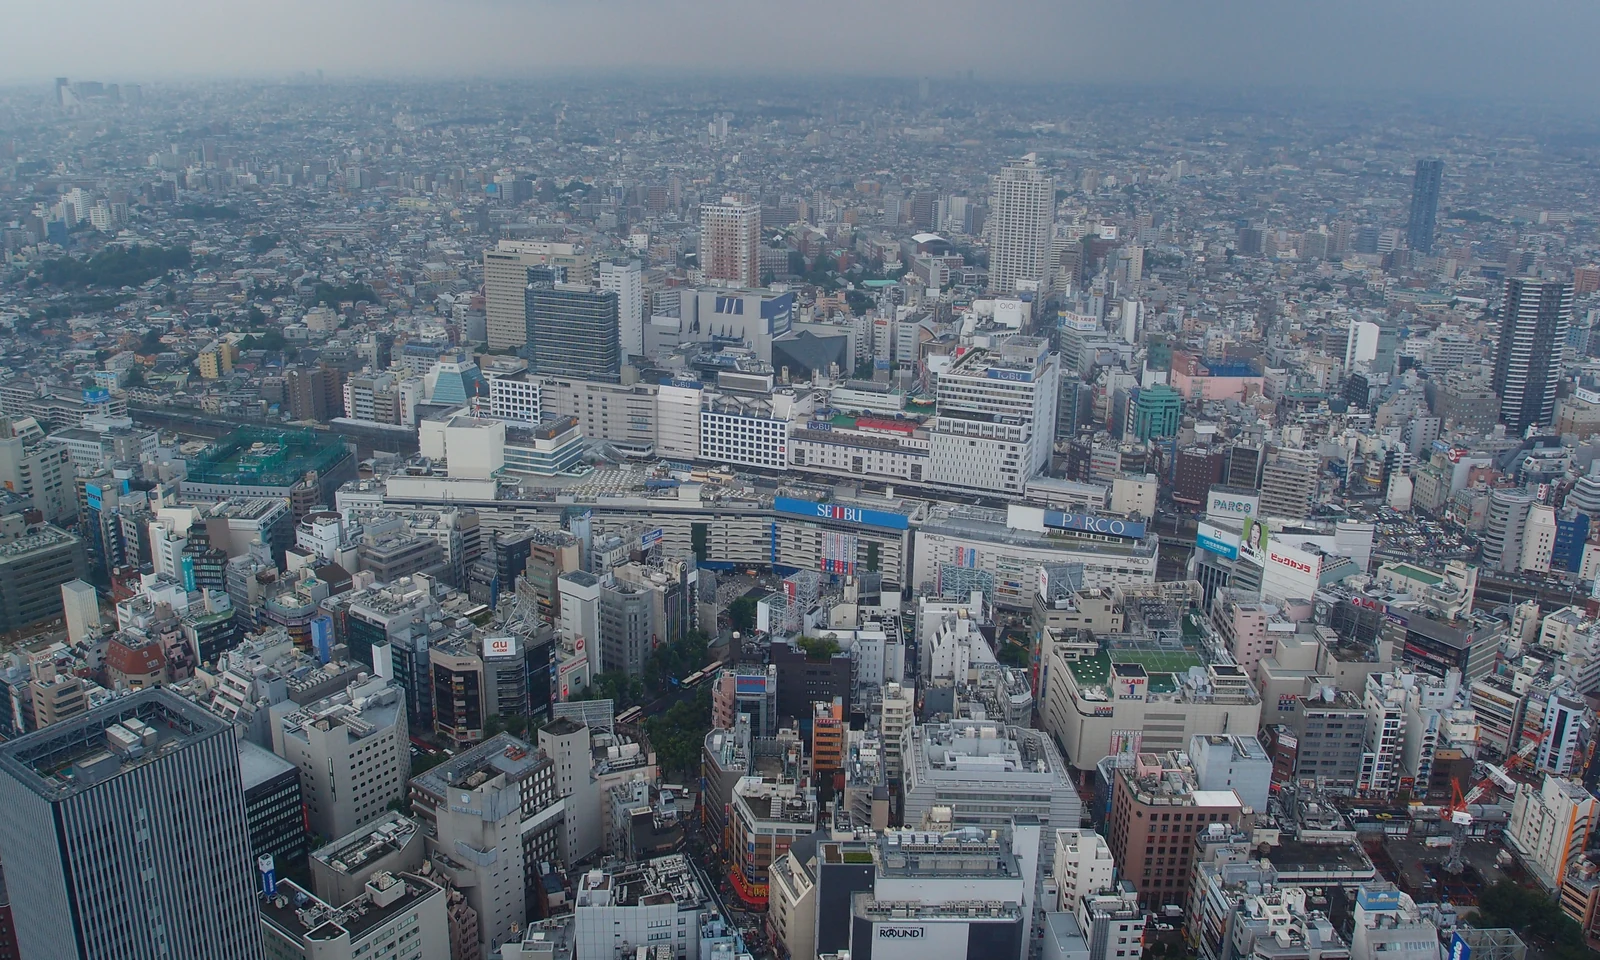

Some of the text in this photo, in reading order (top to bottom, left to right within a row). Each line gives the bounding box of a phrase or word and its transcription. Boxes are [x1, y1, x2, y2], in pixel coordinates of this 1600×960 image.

[996, 371, 1022, 381] TOBU
[807, 422, 830, 431] TOBU
[1213, 499, 1252, 513] PARCO
[817, 504, 862, 522] SEIBU
[1062, 513, 1125, 534] PARCO
[924, 534, 946, 542] PARCO
[1127, 557, 1149, 565] PARCO
[1270, 553, 1311, 573] ビックカメラ
[880, 928, 924, 938] ROUND1
